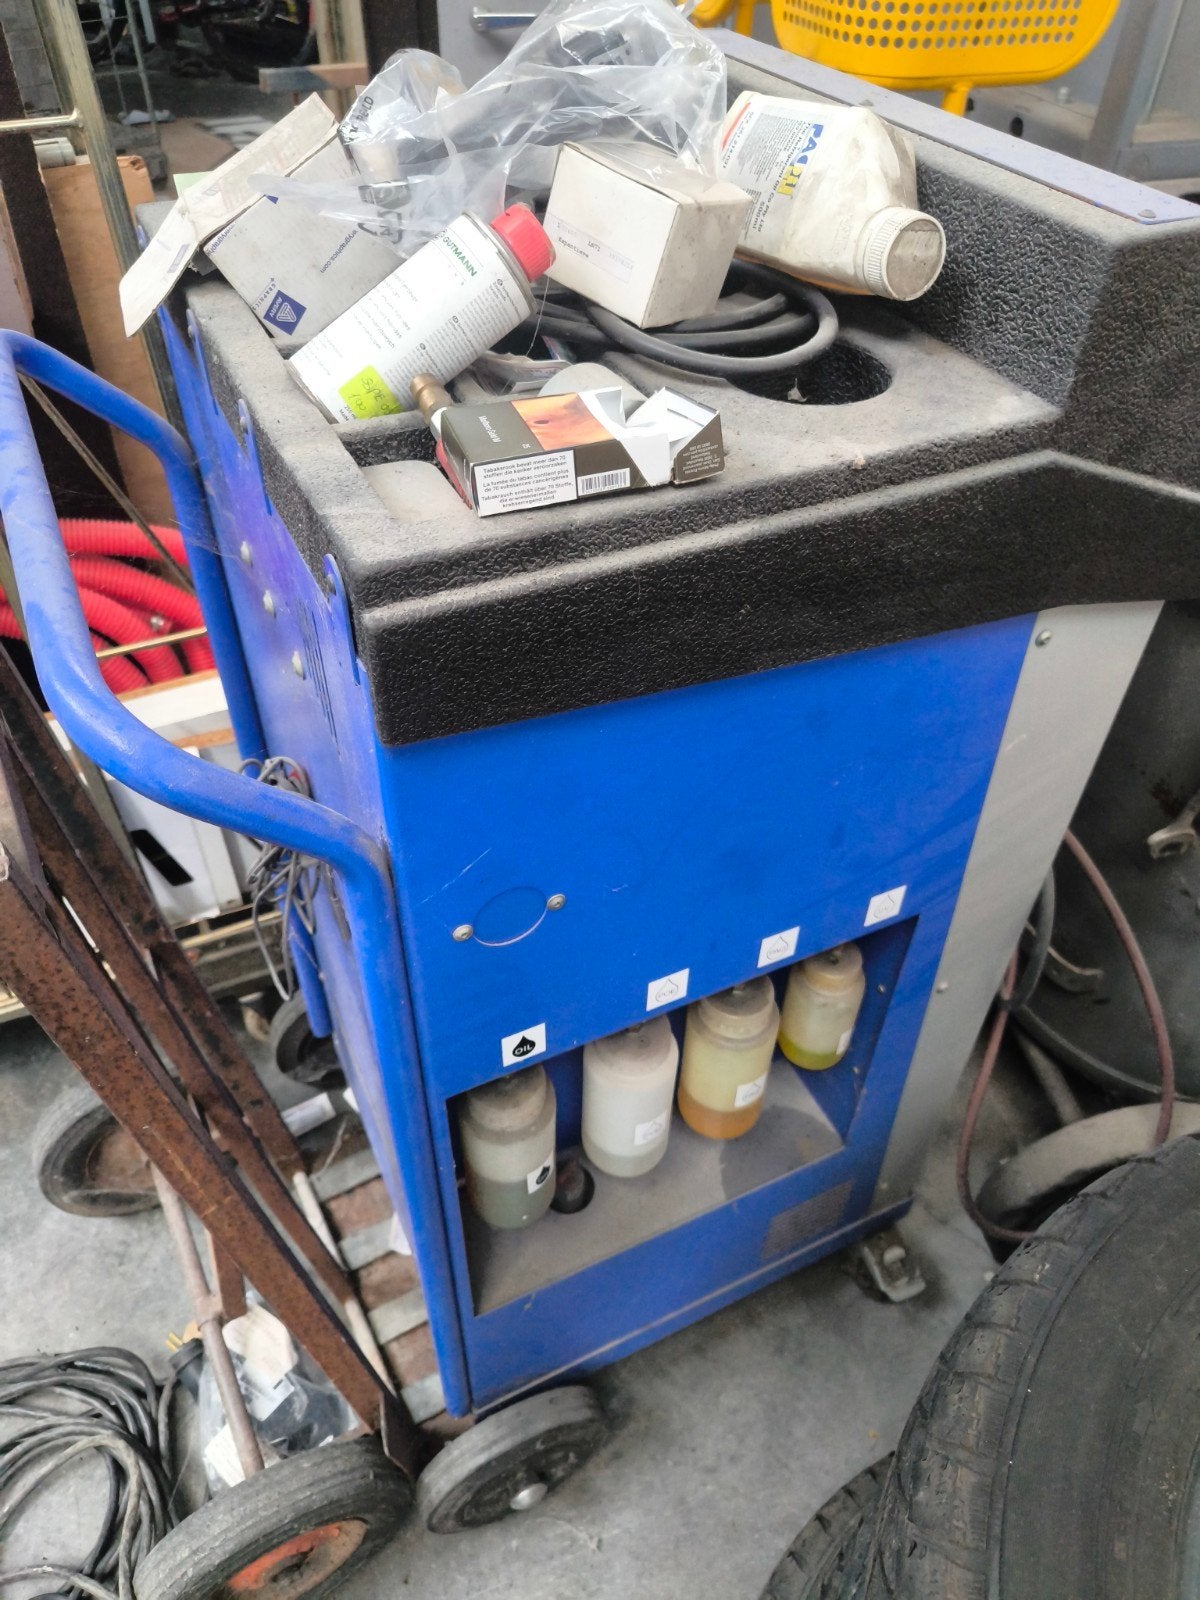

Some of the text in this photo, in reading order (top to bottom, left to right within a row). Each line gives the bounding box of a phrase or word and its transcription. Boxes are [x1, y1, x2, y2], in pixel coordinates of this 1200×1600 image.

[780, 137, 802, 178] Refrigerant
[442, 234, 477, 277] GUTMANN
[271, 297, 282, 317] AVERY
[484, 464, 516, 474] Tabaksrook
[534, 461, 567, 470] veroorzaken
[534, 471, 556, 479] contient
[500, 481, 531, 490] substances
[533, 474, 568, 485] cancérigènes
[482, 492, 513, 501] Tabakrauch
[503, 498, 542, 508] krebserregend
[515, 1044, 532, 1055] OIL
